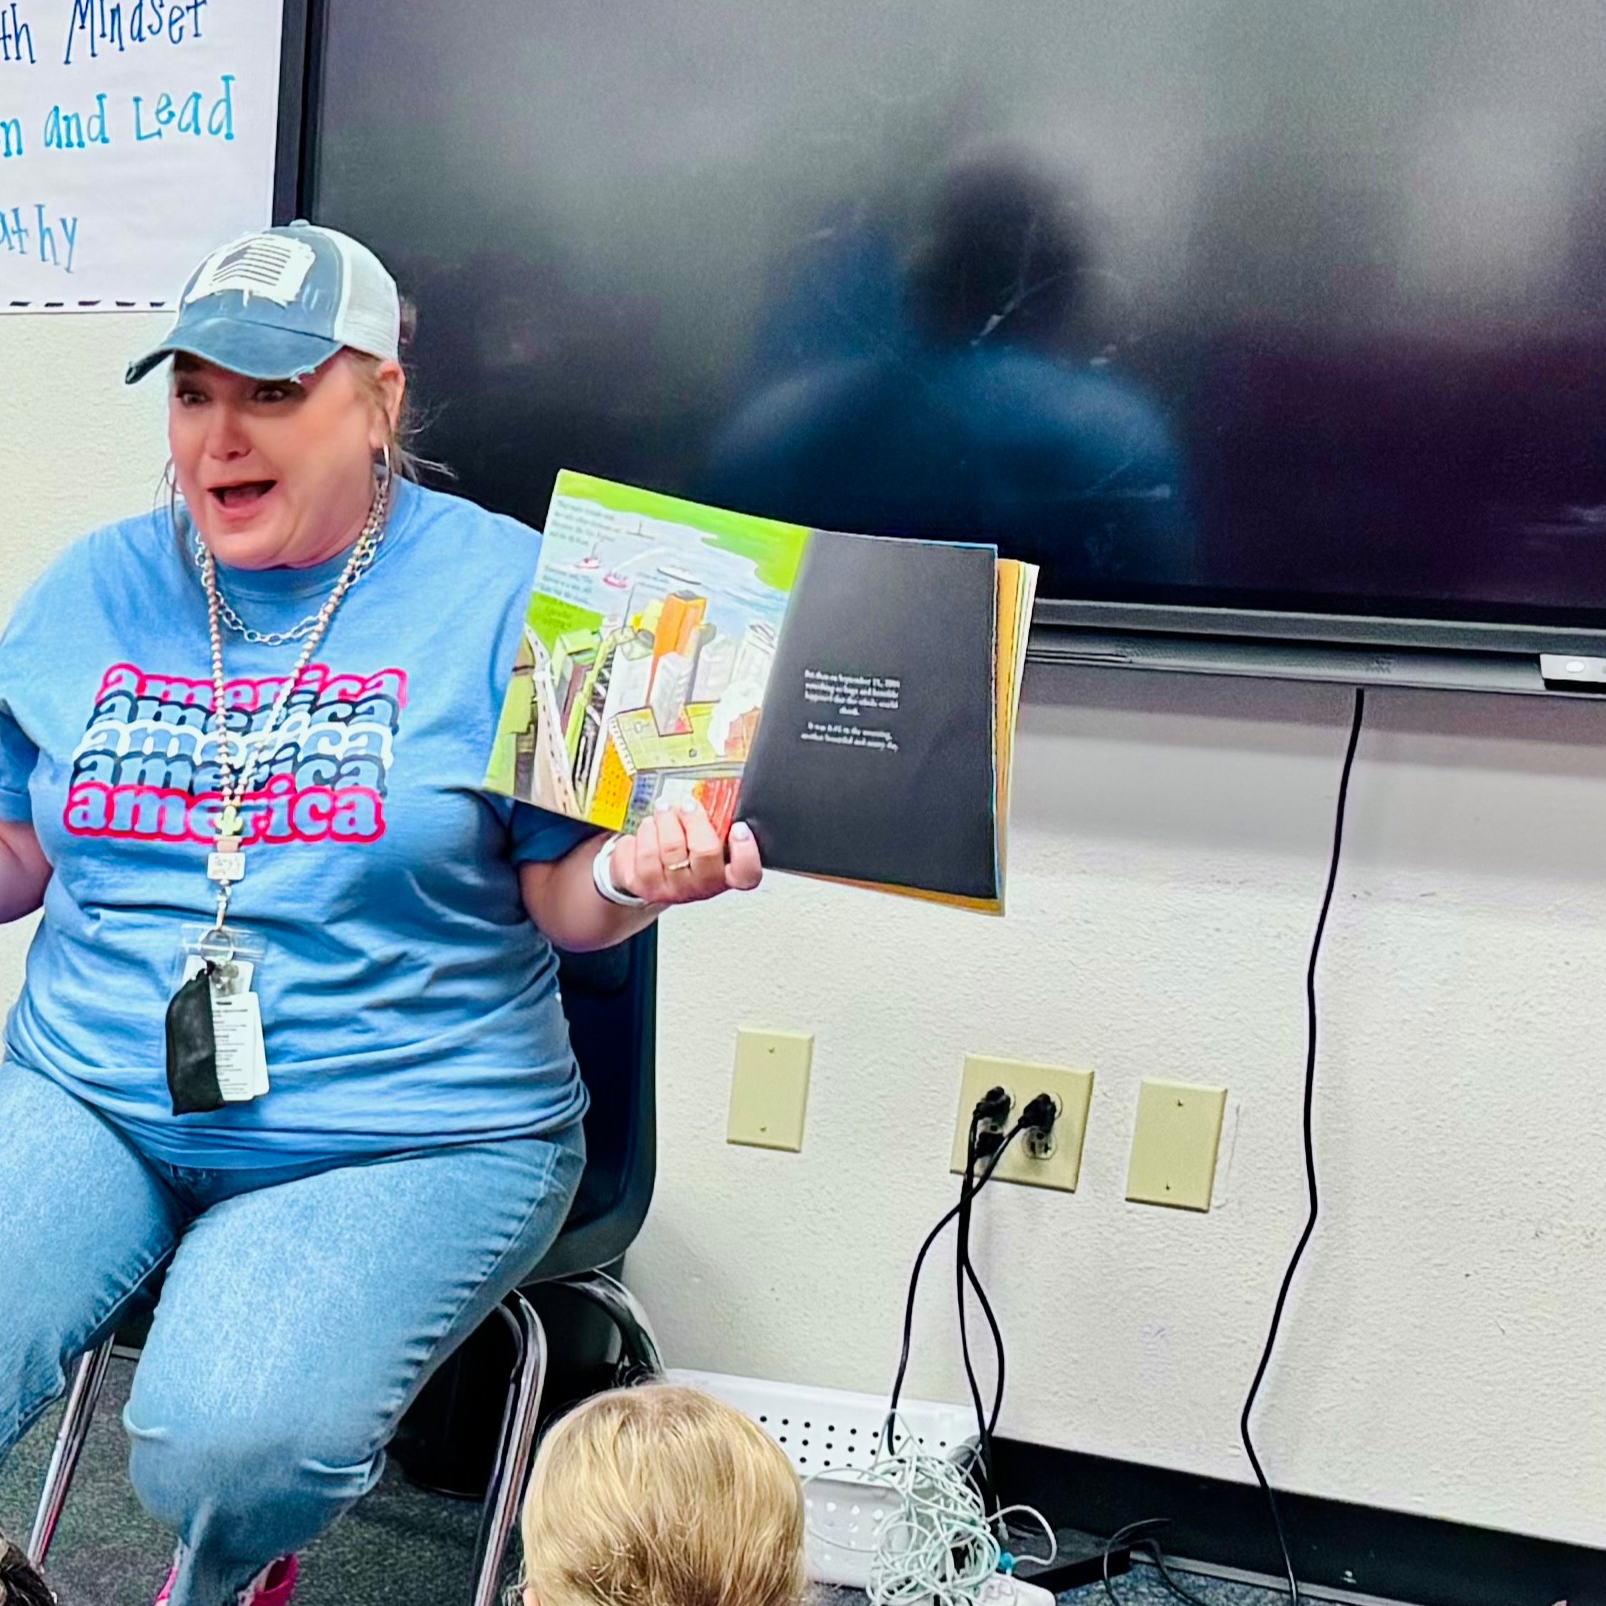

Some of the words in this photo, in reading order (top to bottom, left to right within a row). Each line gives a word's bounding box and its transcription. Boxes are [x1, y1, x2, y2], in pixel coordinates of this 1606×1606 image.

[64, 0, 208, 65] Mindset
[44, 93, 110, 150] and
[133, 75, 237, 142] Lead
[63, 773, 387, 847] america
